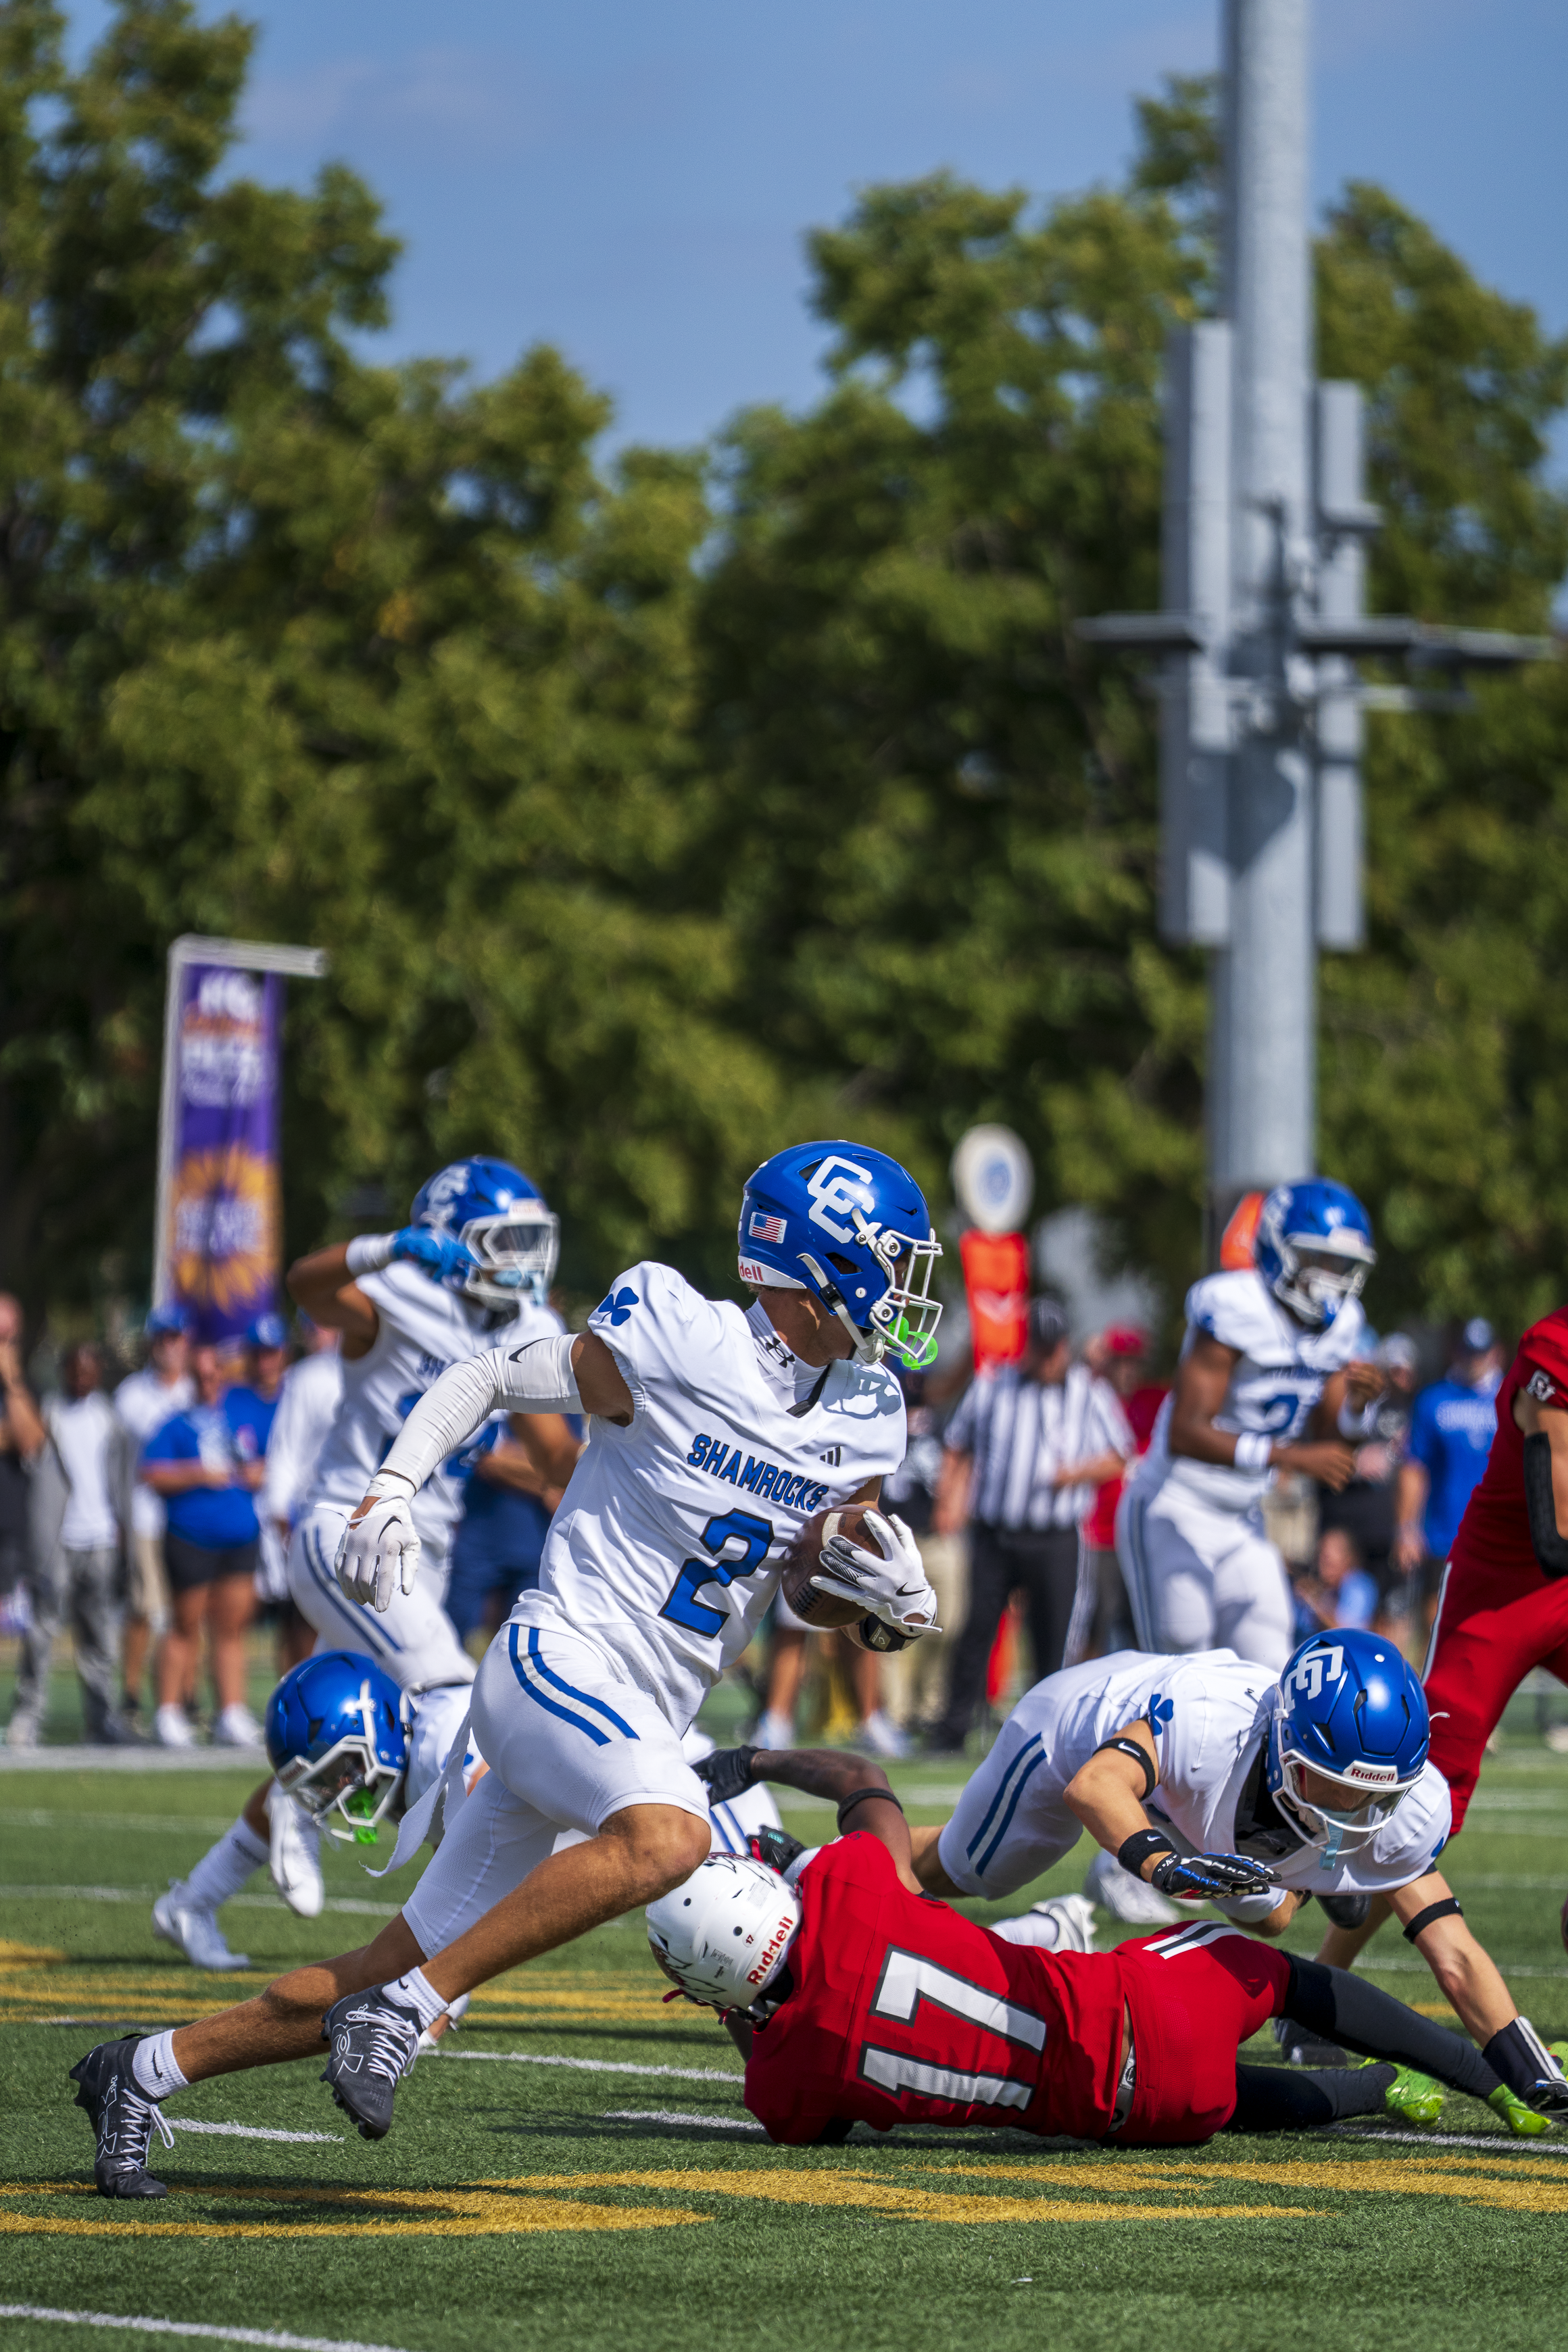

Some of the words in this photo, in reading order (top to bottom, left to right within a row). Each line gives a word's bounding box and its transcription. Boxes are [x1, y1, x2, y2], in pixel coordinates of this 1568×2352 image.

[739, 1261, 764, 1282] dell
[687, 1433, 829, 1513] SHAMROCKS
[657, 1507, 775, 1639] 2
[1350, 1768, 1396, 1782] Riddell
[745, 1934, 755, 1945] 17
[746, 1915, 794, 1986] Riddell
[856, 1942, 1047, 2113] 17
